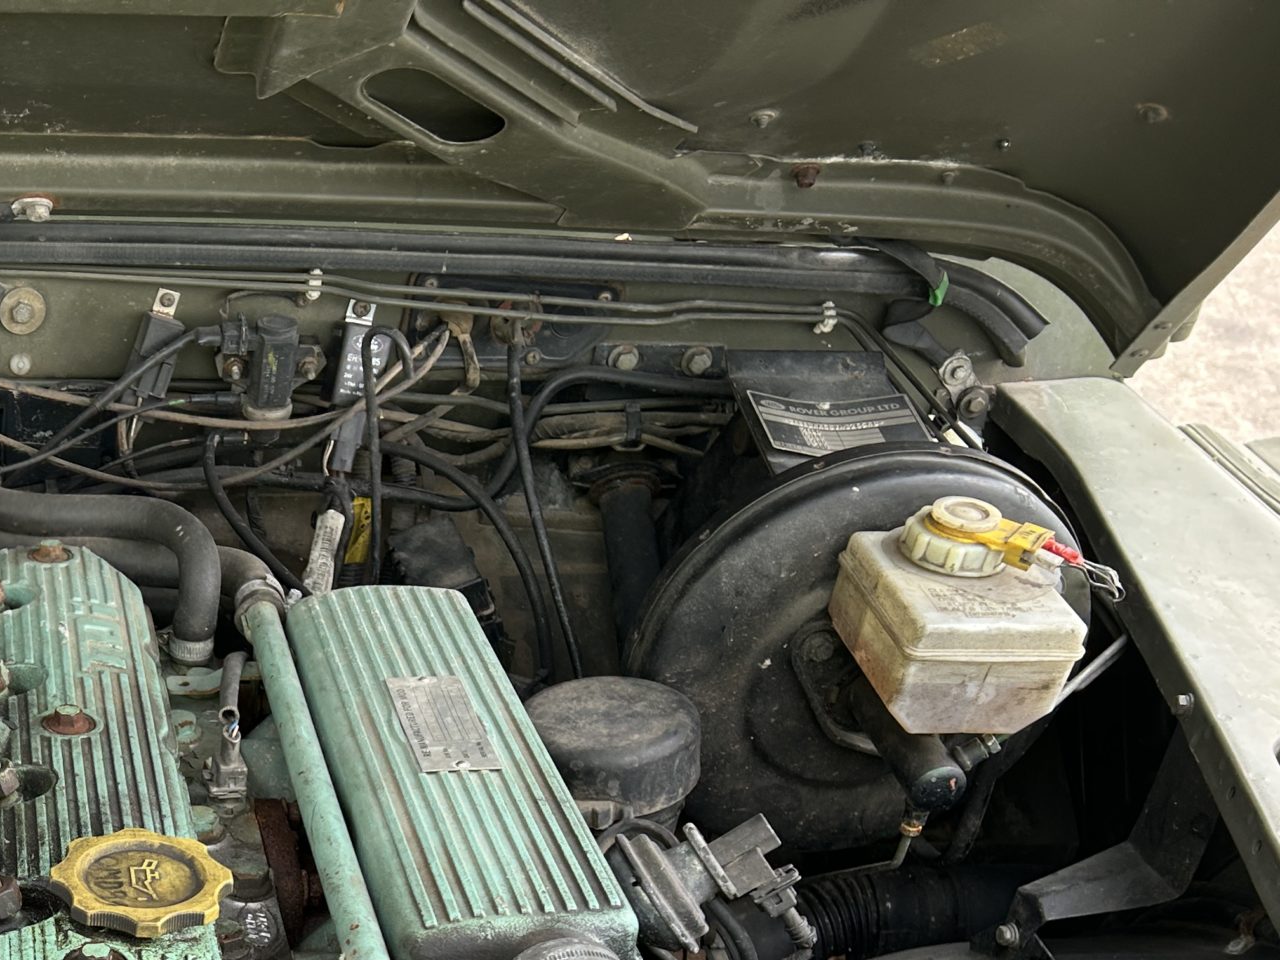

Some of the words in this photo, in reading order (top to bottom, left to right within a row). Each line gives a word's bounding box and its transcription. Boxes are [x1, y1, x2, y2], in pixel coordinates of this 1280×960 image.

[789, 406, 828, 417] ROVER
[830, 405, 876, 416] GROUP
[878, 402, 901, 412] LTD
